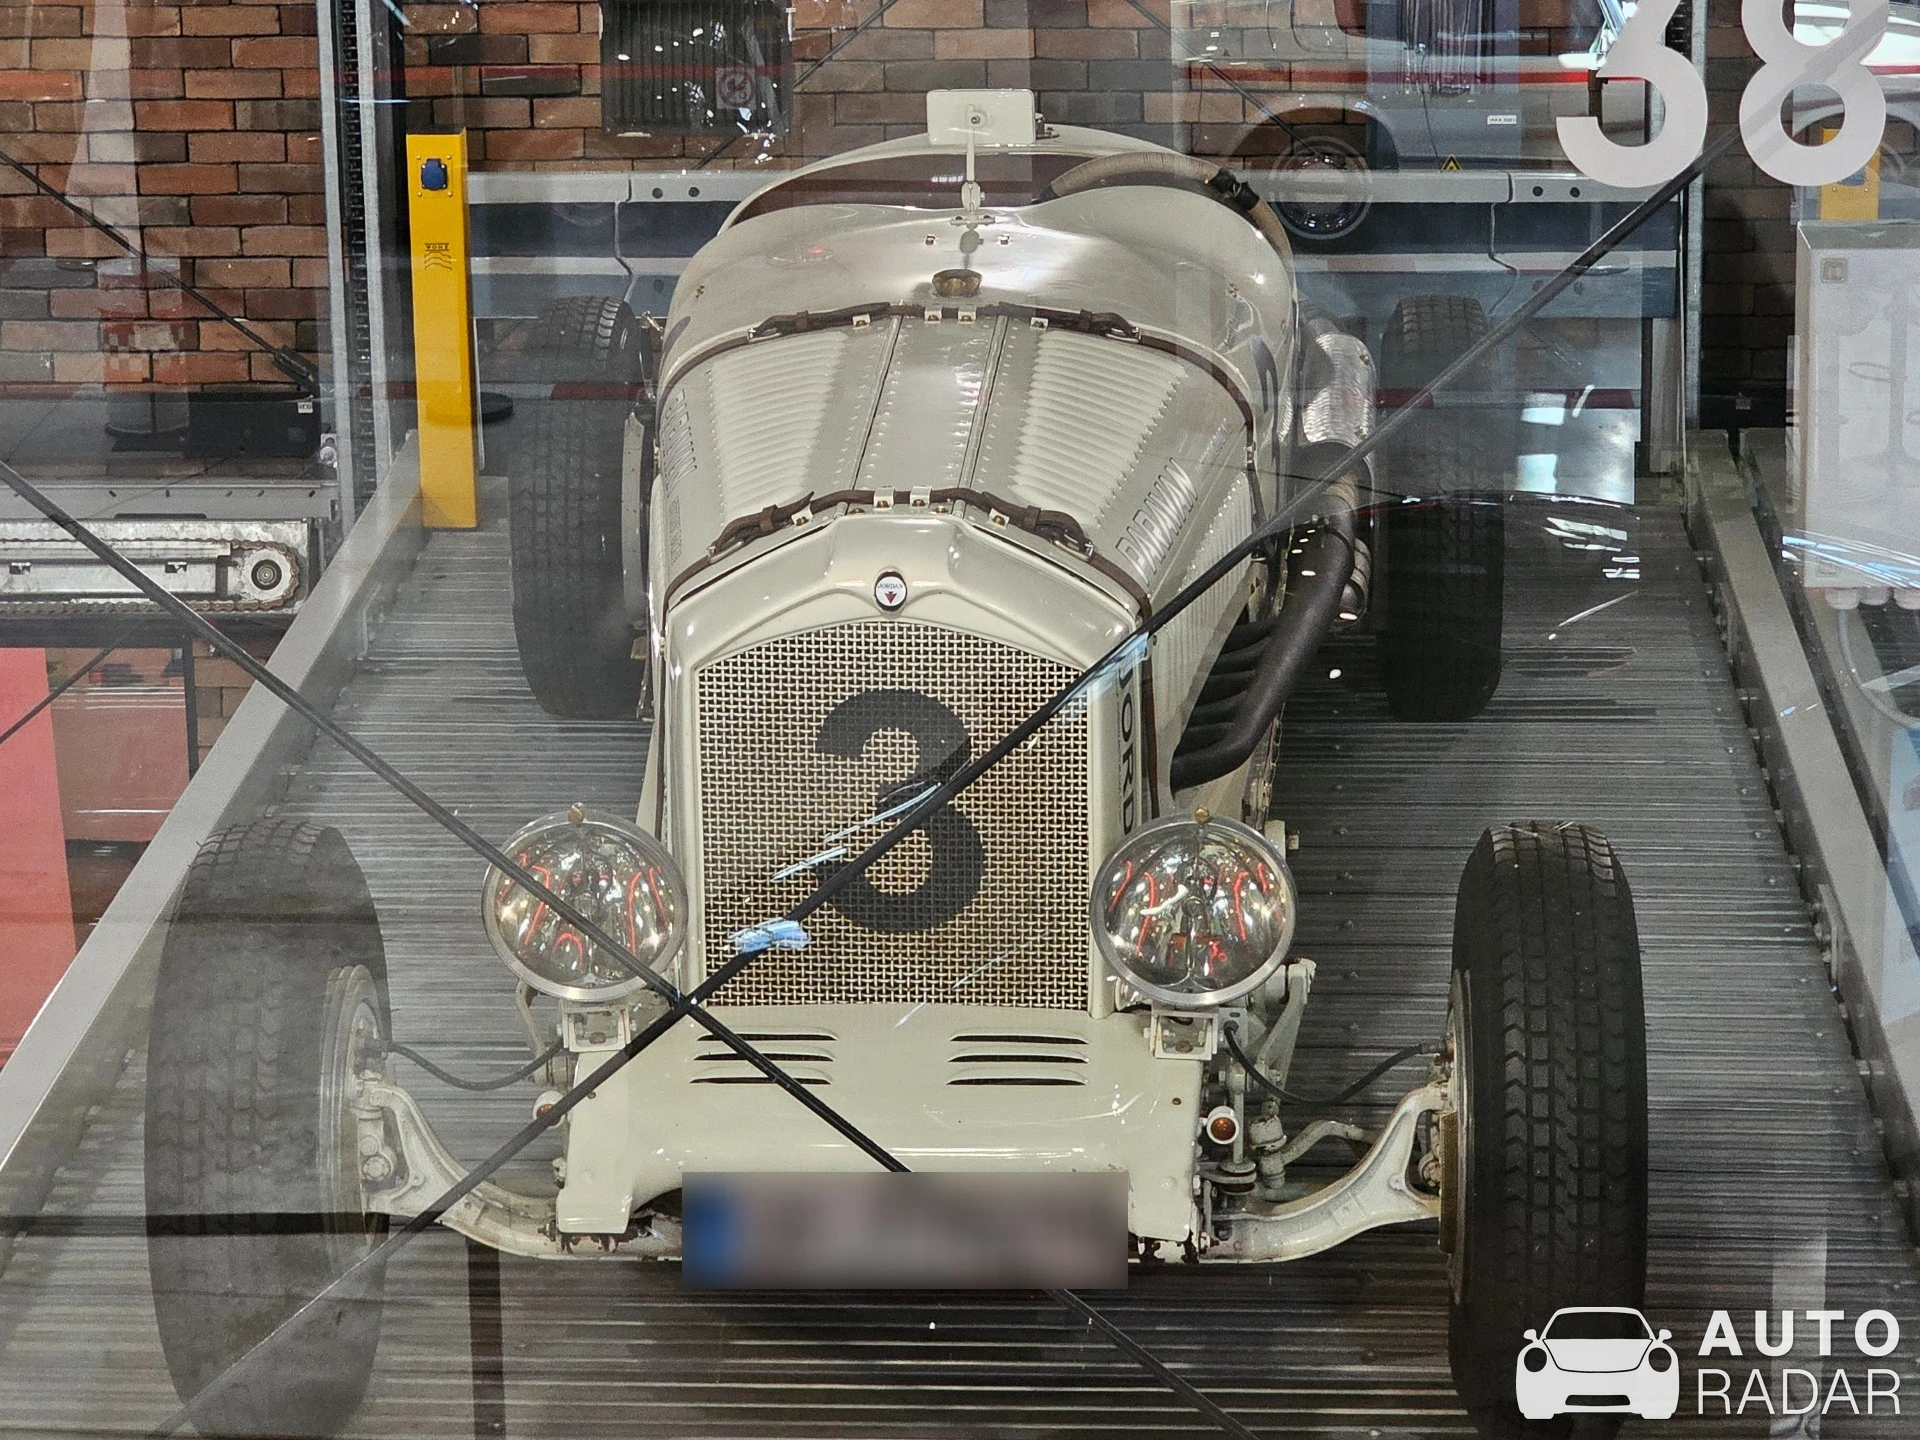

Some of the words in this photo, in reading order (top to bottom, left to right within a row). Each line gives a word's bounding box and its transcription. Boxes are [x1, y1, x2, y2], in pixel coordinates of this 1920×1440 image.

[1556, 0, 1887, 188] 38
[1115, 457, 1198, 587] PARAVAN
[814, 688, 985, 931] 3
